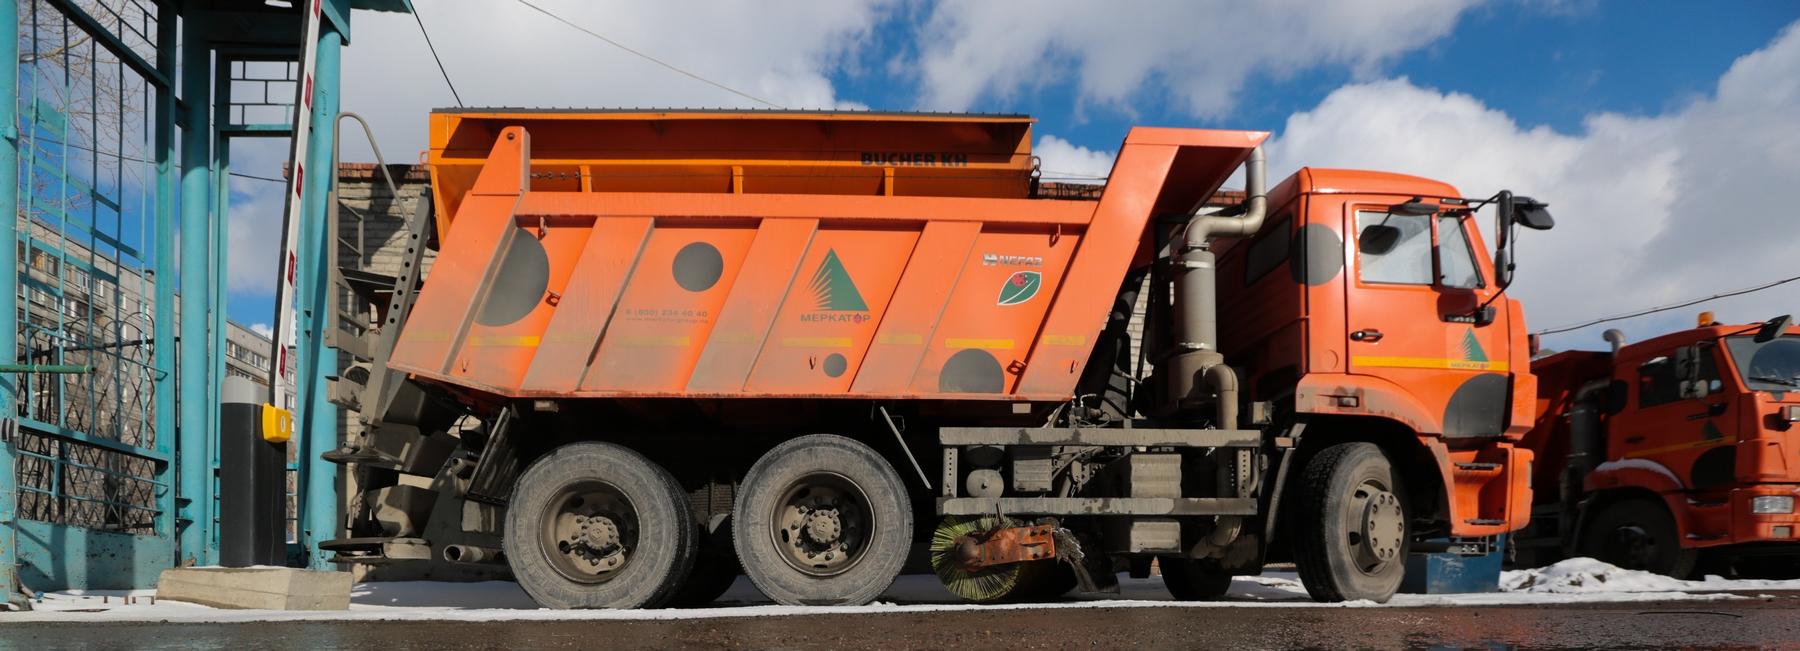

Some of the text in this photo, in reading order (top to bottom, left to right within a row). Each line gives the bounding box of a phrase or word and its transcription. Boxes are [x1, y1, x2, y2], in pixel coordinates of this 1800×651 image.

[861, 151, 936, 167] BUCHER
[696, 310, 708, 318] 40
[800, 313, 872, 323] МЕРКАТОР
